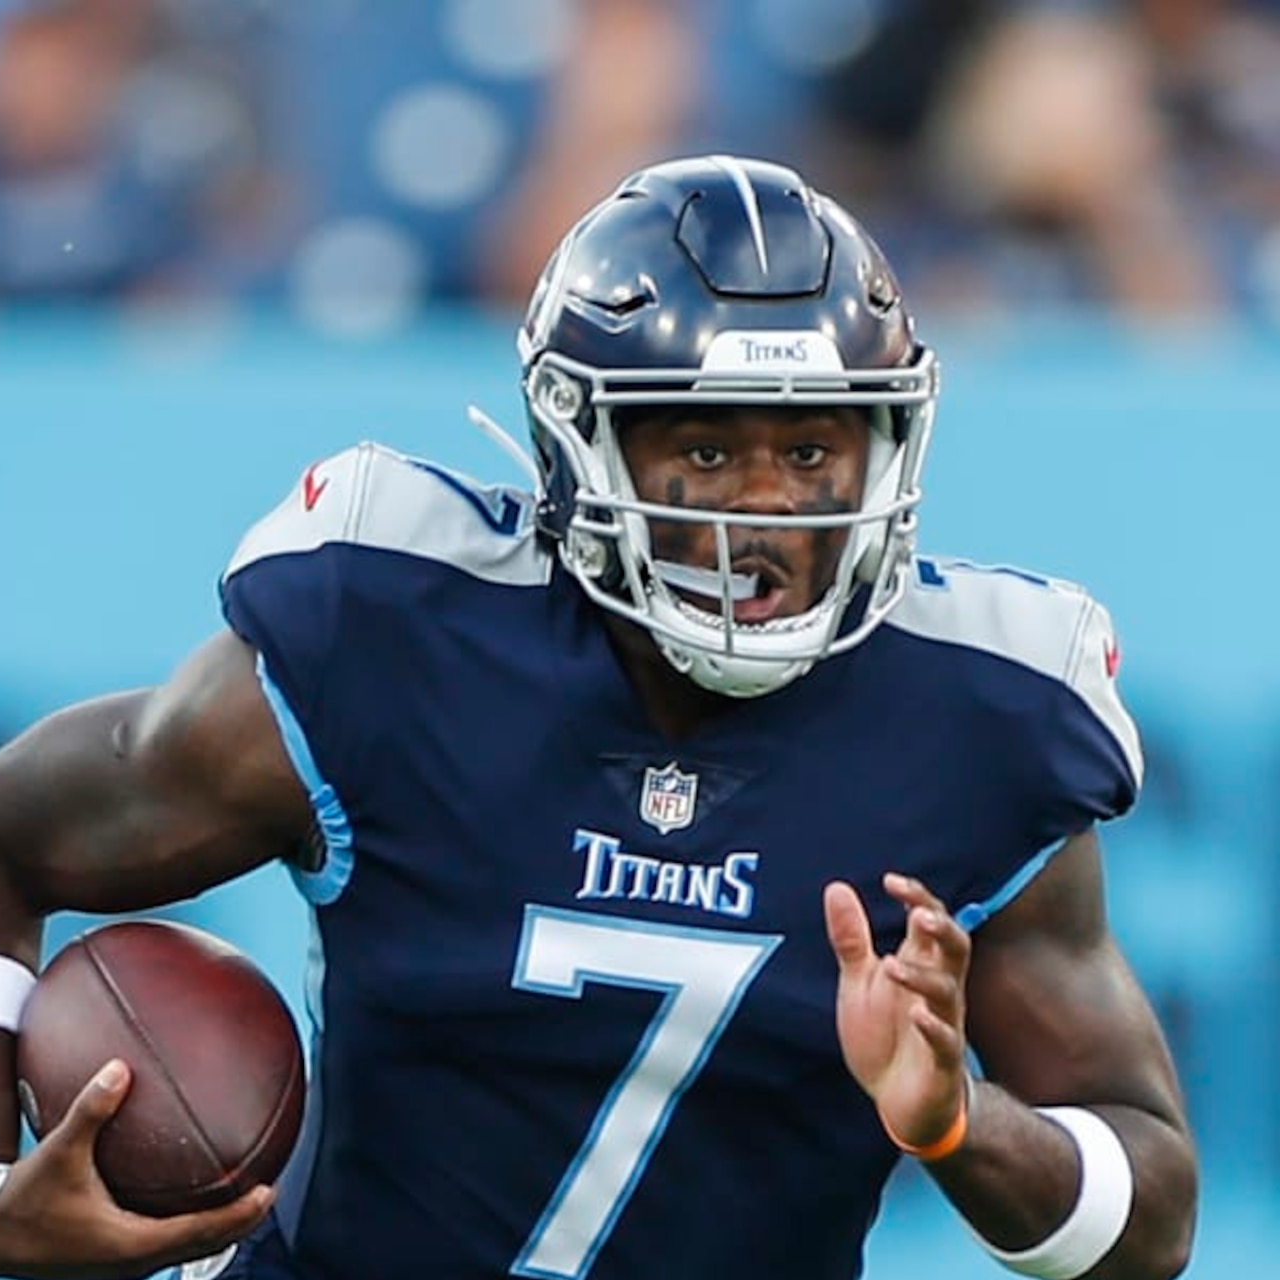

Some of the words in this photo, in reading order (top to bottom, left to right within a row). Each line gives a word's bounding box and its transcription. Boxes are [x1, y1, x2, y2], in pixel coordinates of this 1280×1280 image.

[739, 338, 808, 362] TITANS
[648, 793, 686, 820] NFL
[572, 829, 760, 920] TITANS
